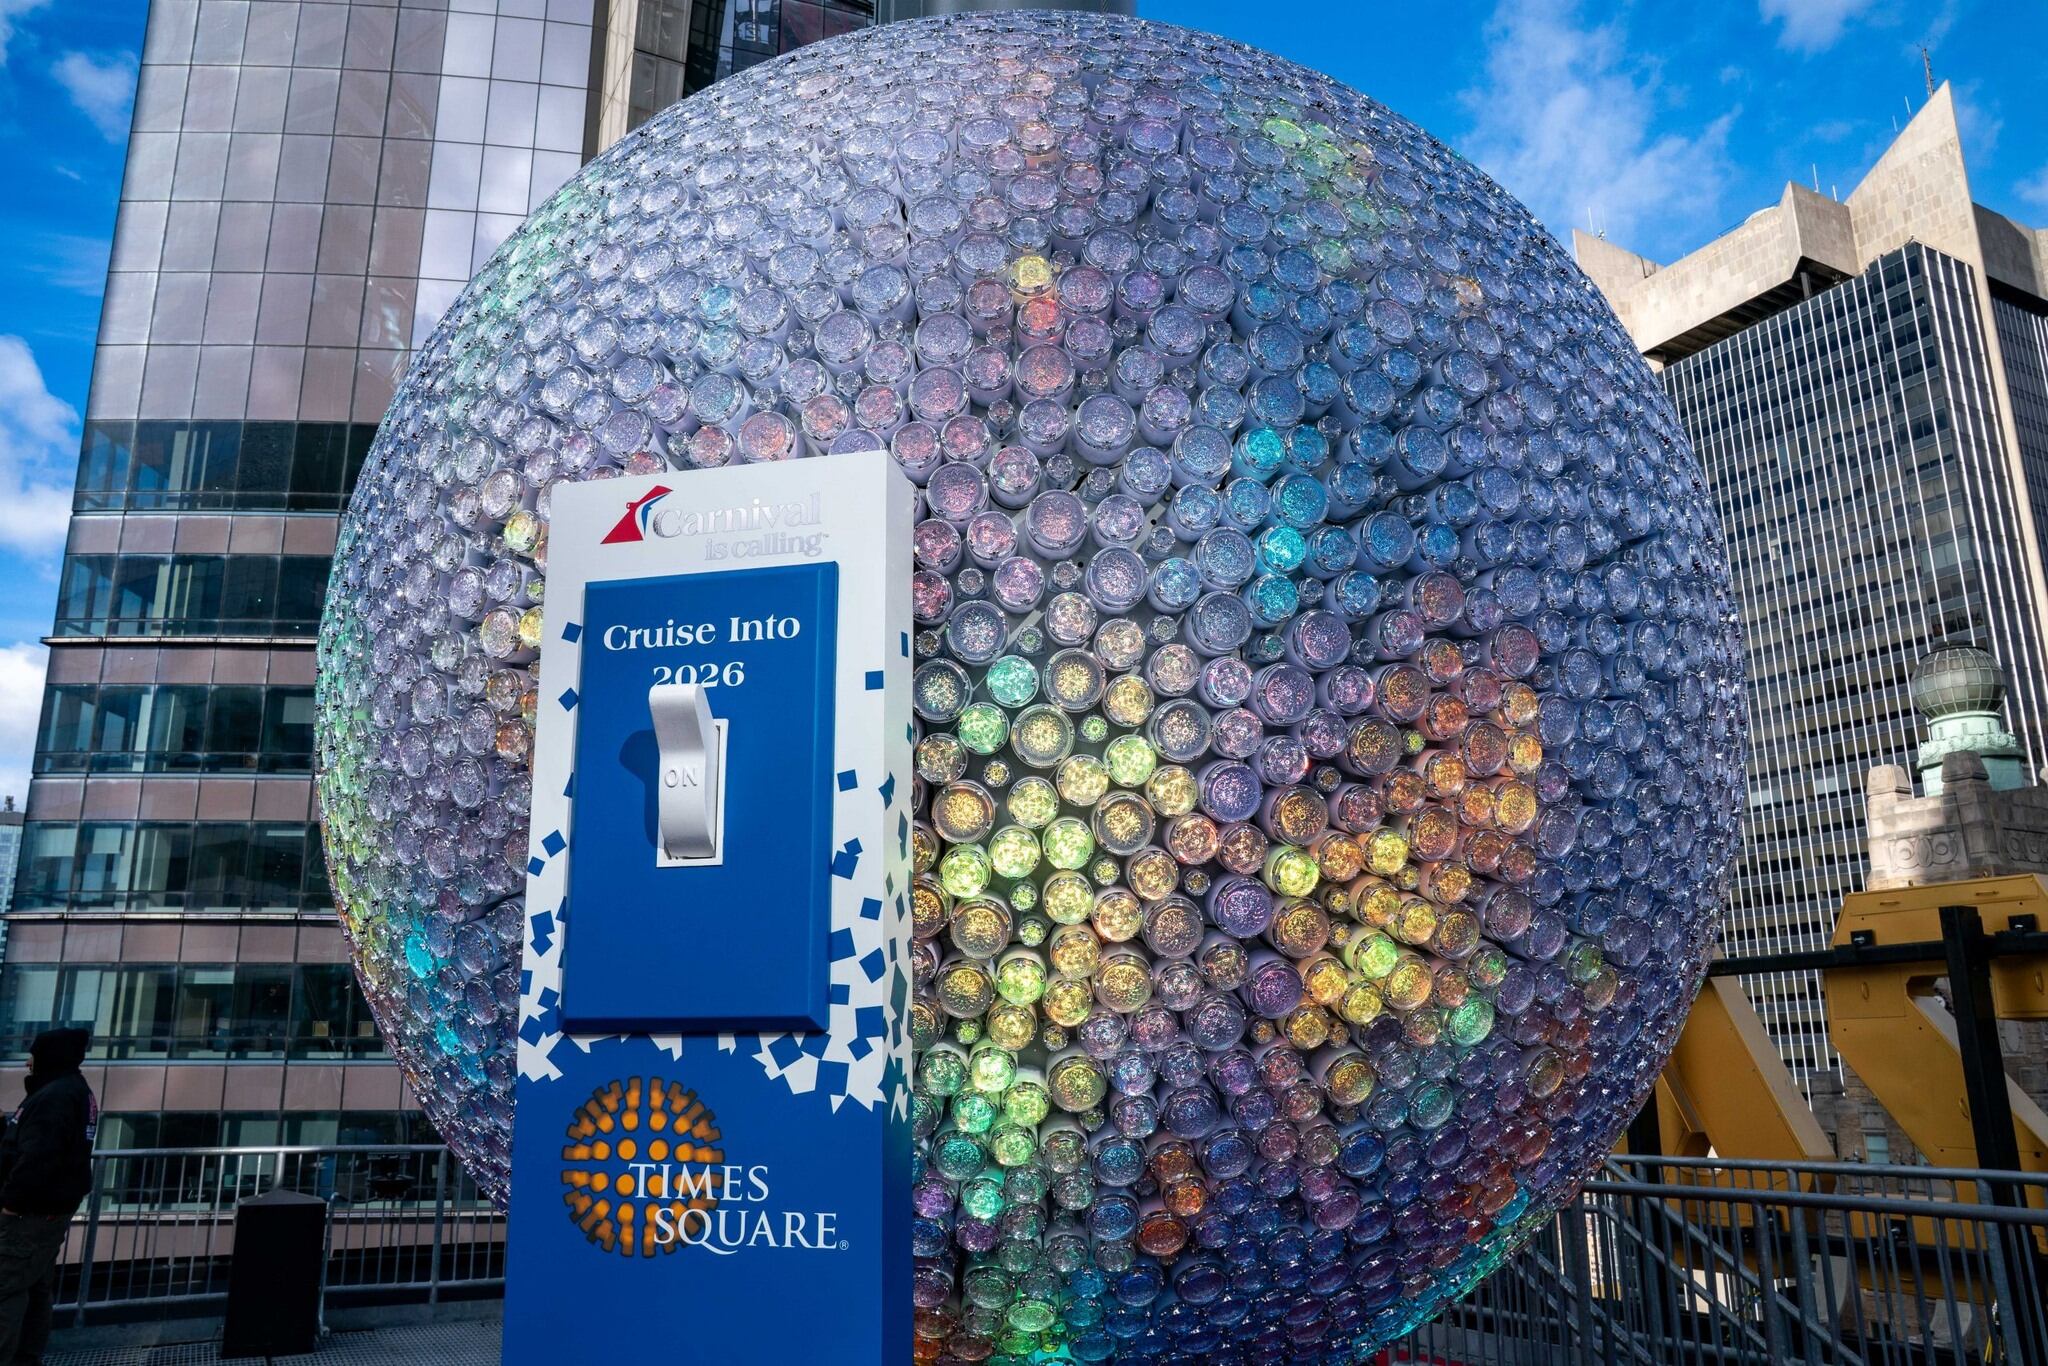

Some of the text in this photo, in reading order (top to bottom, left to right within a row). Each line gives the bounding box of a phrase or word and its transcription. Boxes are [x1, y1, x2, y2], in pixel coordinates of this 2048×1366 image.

[652, 490, 822, 538] Carnival
[704, 538, 728, 560] is
[603, 614, 800, 651] Cruise Into
[653, 662, 745, 688] 2026
[664, 768, 698, 788] ON
[629, 1163, 769, 1201] TIMES
